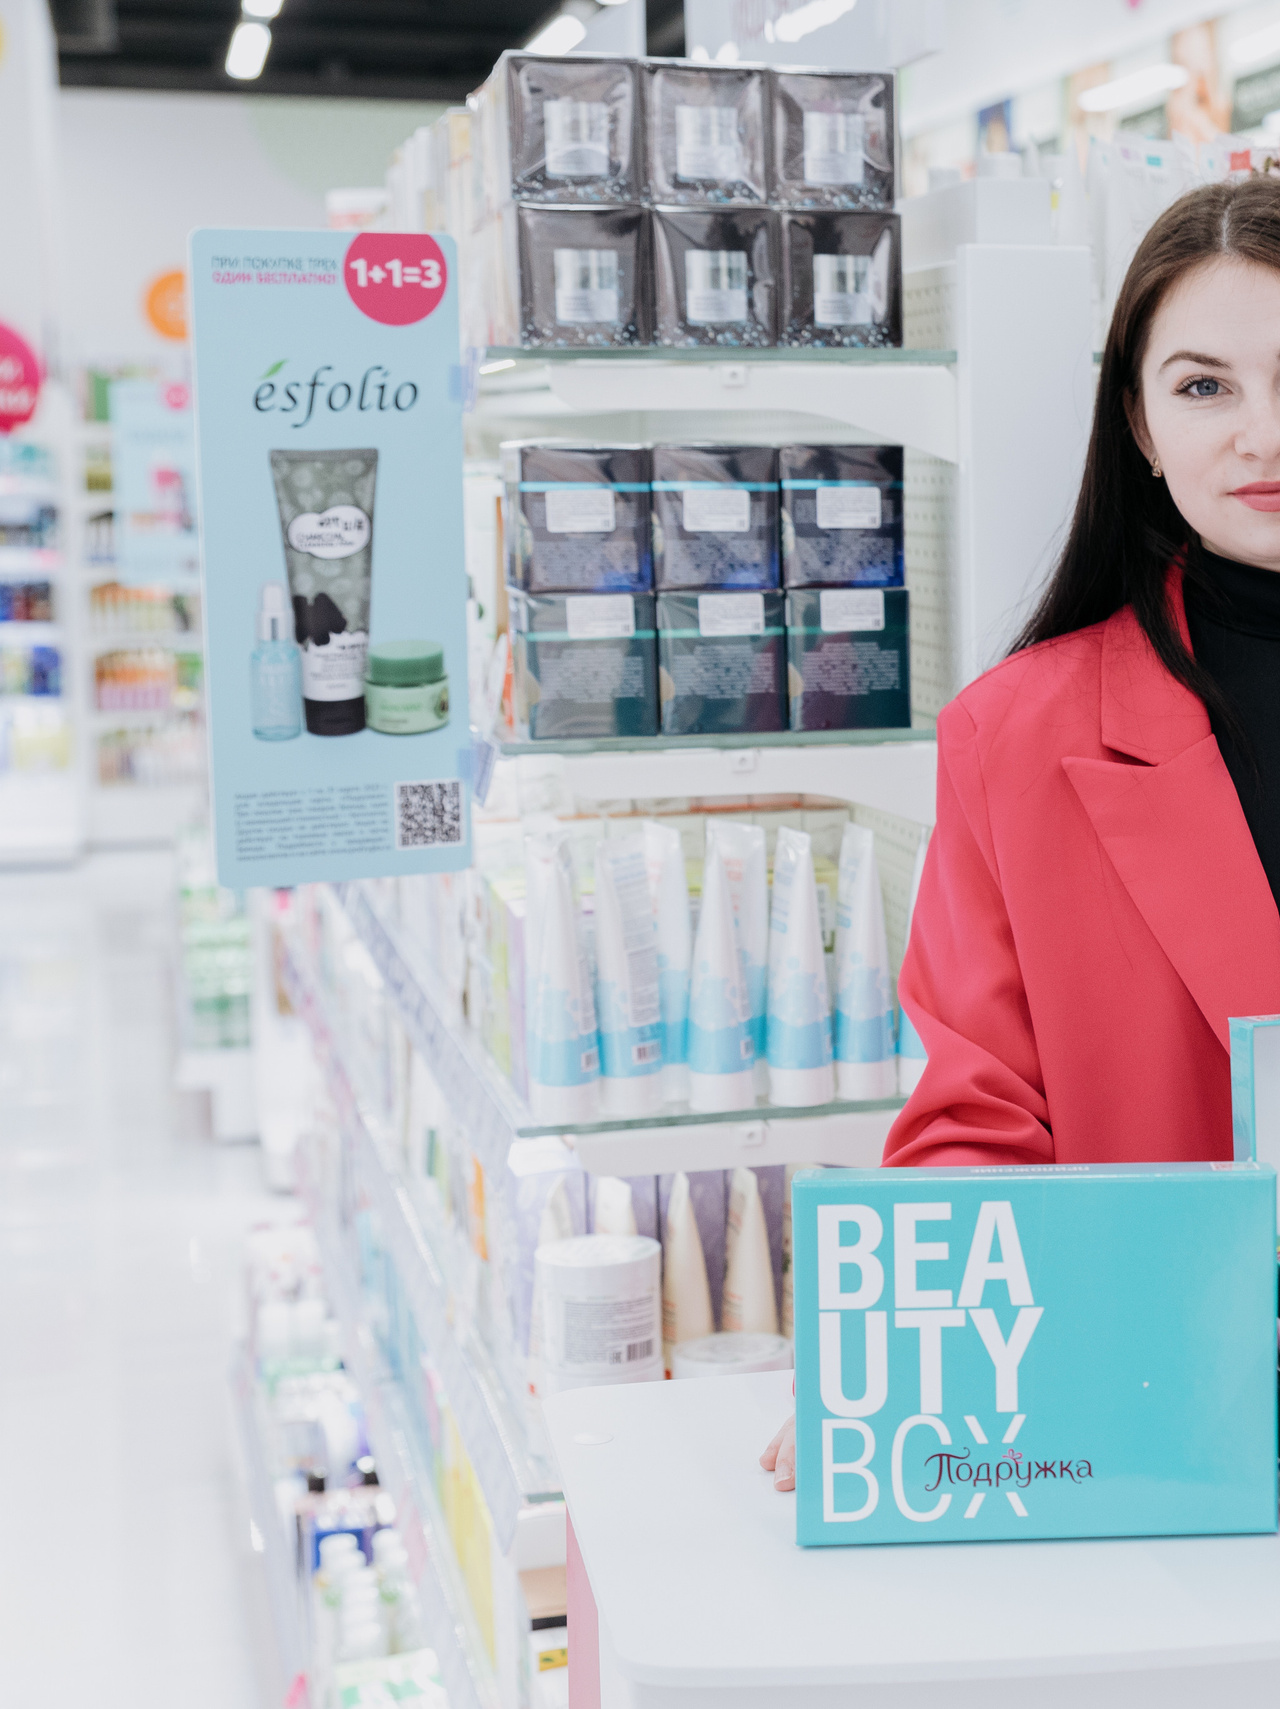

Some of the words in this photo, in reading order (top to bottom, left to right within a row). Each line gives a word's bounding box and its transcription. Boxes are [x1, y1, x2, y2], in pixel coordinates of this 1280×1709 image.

[350, 258, 442, 289] 1+1=3
[817, 1201, 1034, 1310] BEA
[818, 1307, 1045, 1418] UTY
[924, 1447, 1094, 1492] Подружка
